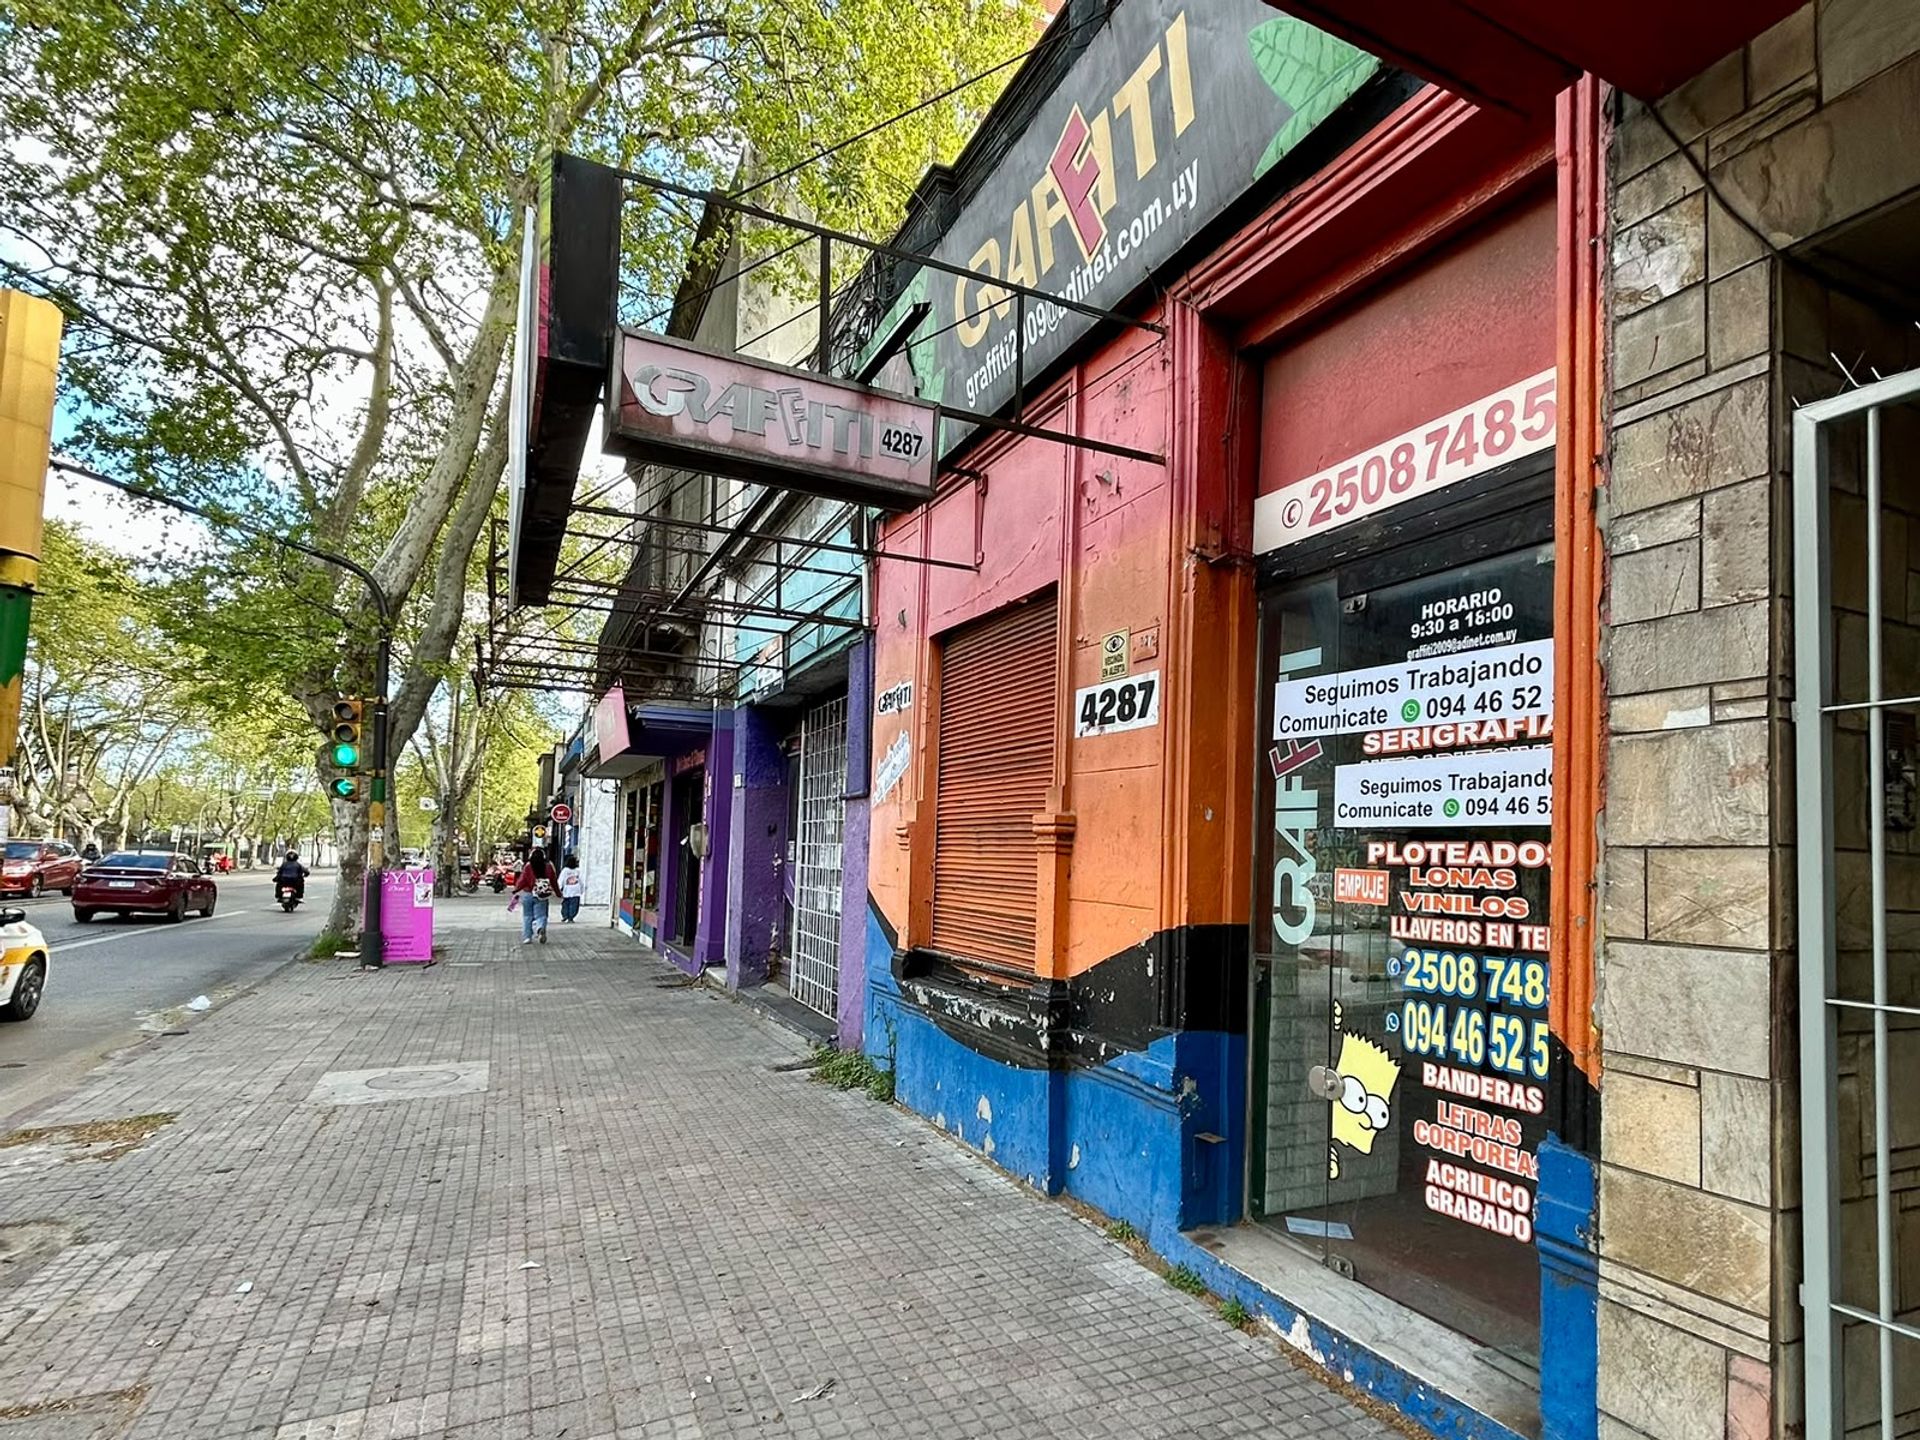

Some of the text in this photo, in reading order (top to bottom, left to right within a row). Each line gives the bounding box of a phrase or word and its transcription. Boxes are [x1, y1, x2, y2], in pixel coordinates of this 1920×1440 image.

[633, 363, 874, 459] GRAFFITI
[882, 427, 924, 458] 4287
[1307, 378, 1557, 528] 2508 7485
[1421, 588, 1502, 620] HORARIO
[1410, 617, 1446, 640] 9:30
[1448, 617, 1459, 631] a
[1304, 652, 1543, 706] Seguimos Trabajando
[1081, 680, 1156, 727] 4287
[1279, 704, 1389, 734] Comunicate
[1426, 697, 1467, 719] 094
[1473, 690, 1504, 713] 46
[1511, 685, 1543, 709] 52
[1337, 795, 1553, 820] Comunicate 094 46 5
[1359, 773, 1443, 798] Seguimos
[1367, 840, 1552, 869] PLOTEADO
[1337, 873, 1385, 900] EMPUJE
[1410, 867, 1517, 891] LONAS
[1399, 890, 1530, 918] VINILOS
[1390, 915, 1550, 952] LLAVEROS EN TE
[1403, 948, 1550, 1007] 2508 748
[1402, 998, 1448, 1057] 094
[1451, 1003, 1488, 1067] 46
[1489, 1013, 1527, 1075] 52
[1422, 1061, 1545, 1115] BANDERAS
[1436, 1099, 1523, 1146] LETRAS
[1425, 1158, 1531, 1214] ACRILICO
[1424, 1184, 1534, 1244] GRABADO
